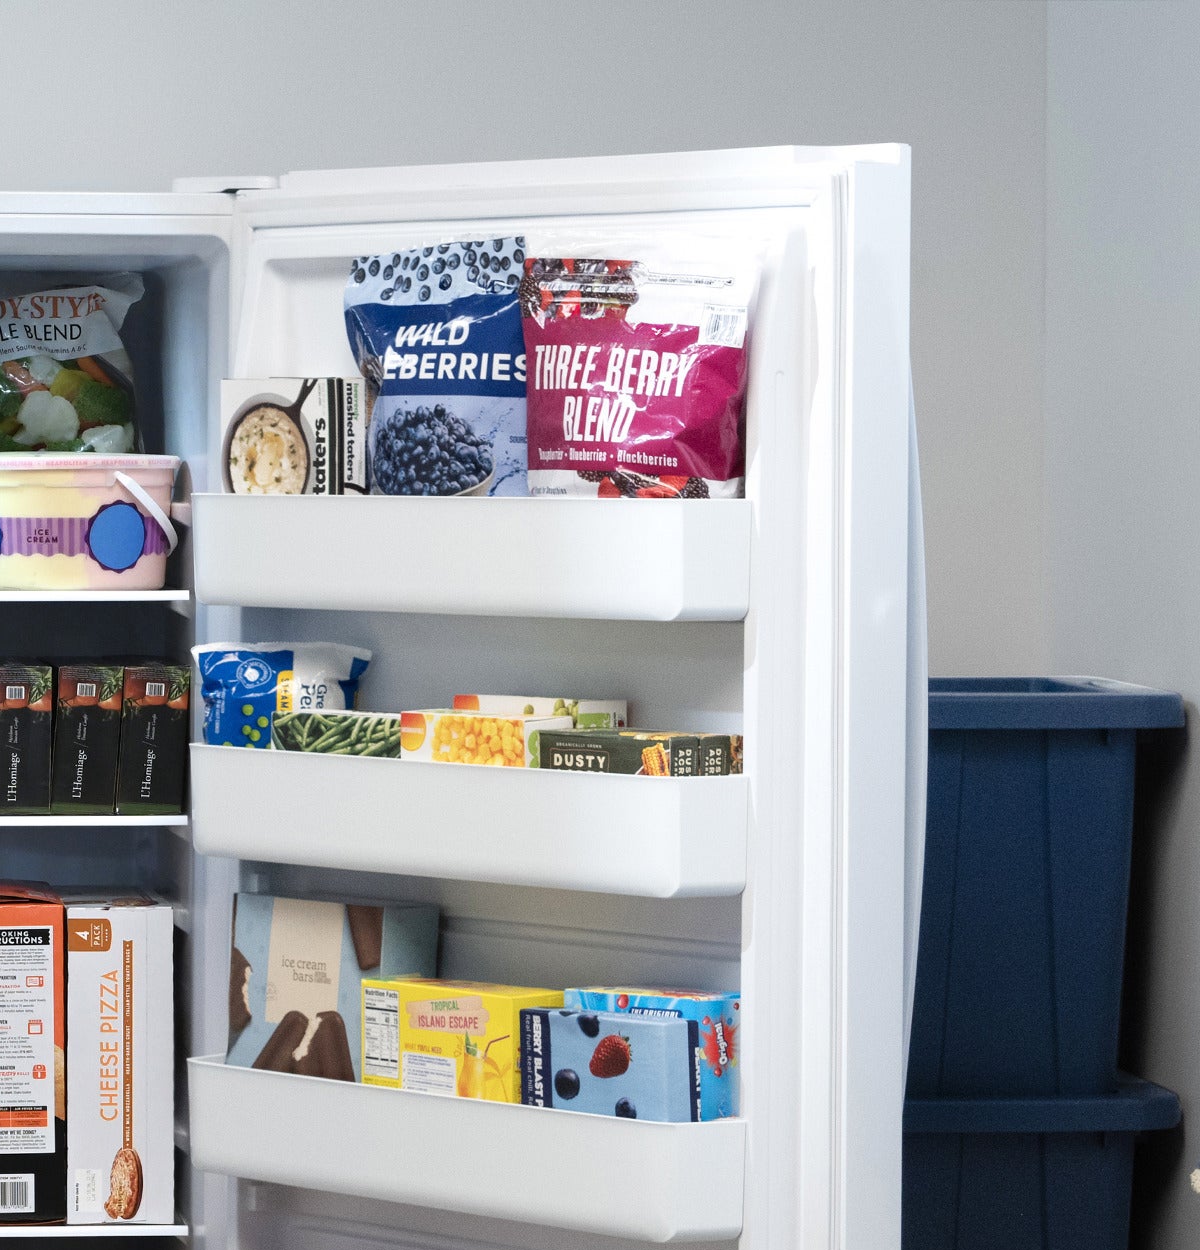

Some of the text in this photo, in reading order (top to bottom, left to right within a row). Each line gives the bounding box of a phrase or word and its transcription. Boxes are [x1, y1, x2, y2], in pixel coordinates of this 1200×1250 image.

[24, 323, 82, 341] BLEND
[395, 320, 470, 347] WILD
[535, 344, 698, 397] THREE BERRY
[563, 396, 636, 443] BLEND
[346, 383, 355, 481] mashed taters
[313, 418, 326, 495] taters
[569, 448, 607, 461] Blueberries
[617, 450, 678, 467] Blackberries
[26, 536, 59, 544] CREAM
[553, 753, 606, 768] DUSTY
[7, 752, 20, 801] L'Homiage
[72, 749, 87, 798] L'Homiage
[140, 749, 154, 798] L'Homiage
[75, 930, 90, 941] 4
[93, 924, 101, 945] PACK
[282, 955, 327, 970] ice cream
[293, 969, 314, 983] bars
[365, 989, 385, 998] Nutrition
[430, 1000, 459, 1011] TROPICAL
[418, 1015, 478, 1029] ISLAND ESCAPE
[99, 969, 119, 1121] CHEESE PIZZA
[715, 1022, 728, 1065] Original
[532, 1015, 544, 1098] BERRY BLAST
